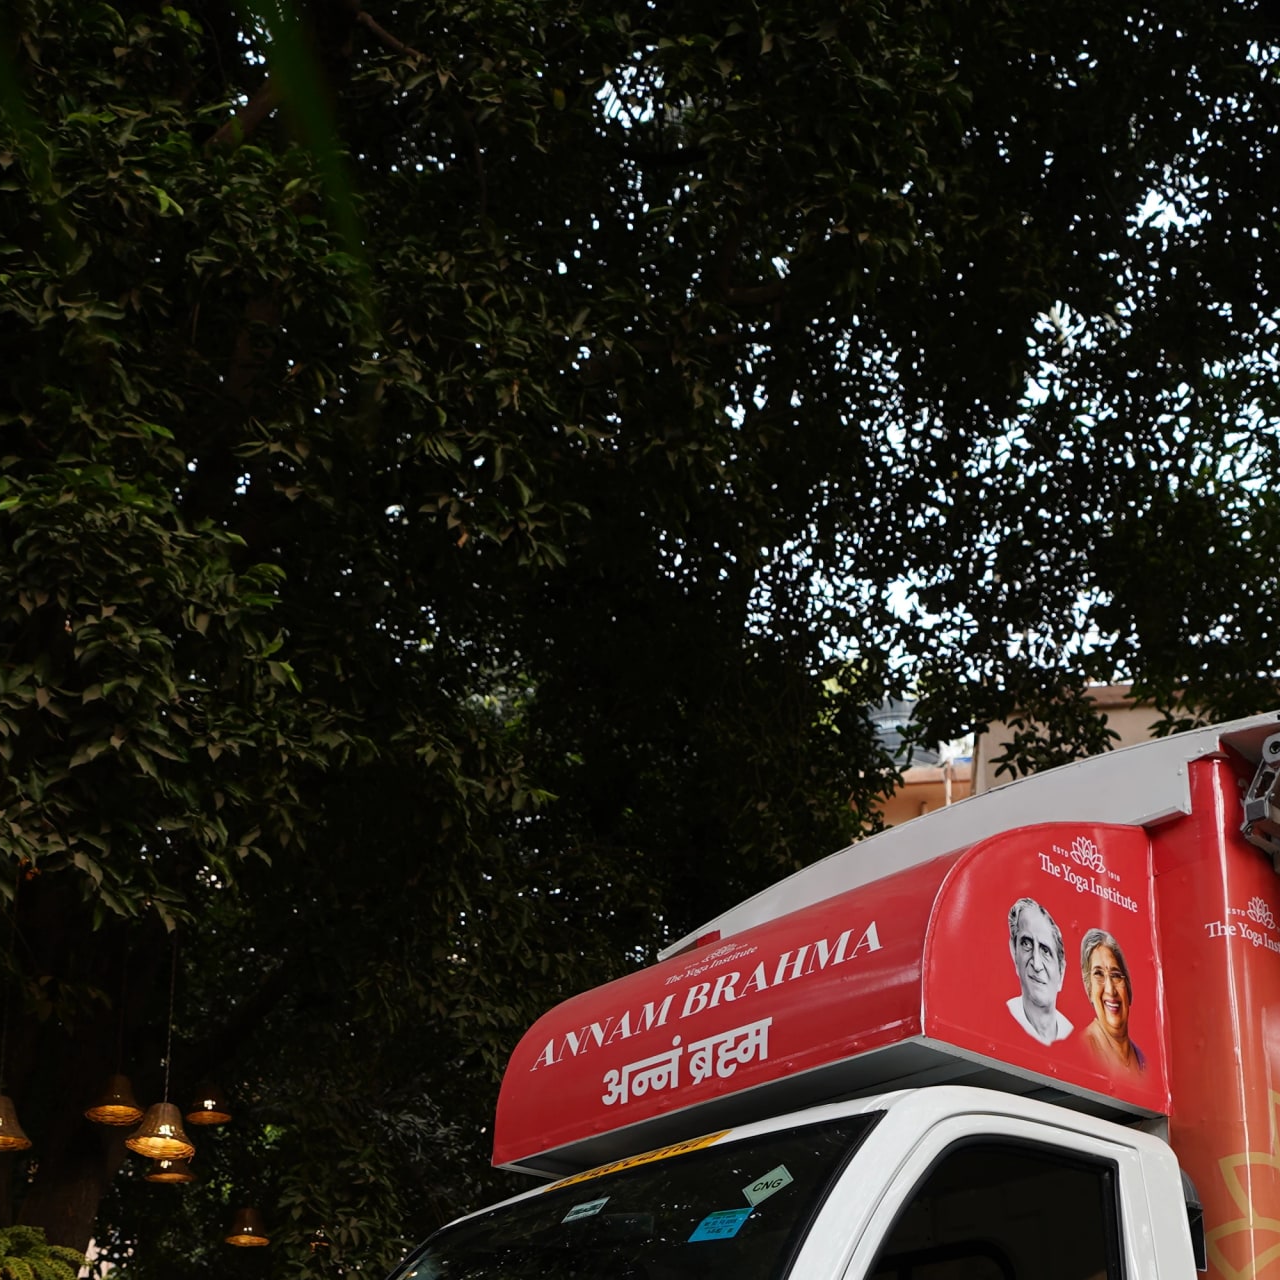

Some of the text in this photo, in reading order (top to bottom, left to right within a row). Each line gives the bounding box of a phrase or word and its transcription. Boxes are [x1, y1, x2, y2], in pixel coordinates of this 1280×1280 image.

[1052, 845, 1069, 858] ESTD
[1038, 852, 1138, 913] The Yoga Institute
[1204, 921, 1237, 938] The
[1237, 921, 1263, 947] Yoga
[709, 946, 758, 969] Institute
[530, 920, 883, 1072] ANNAM BRAHMA
[601, 1016, 773, 1106] अन्नं ब्रह्म
[752, 1178, 784, 1193] CNG
